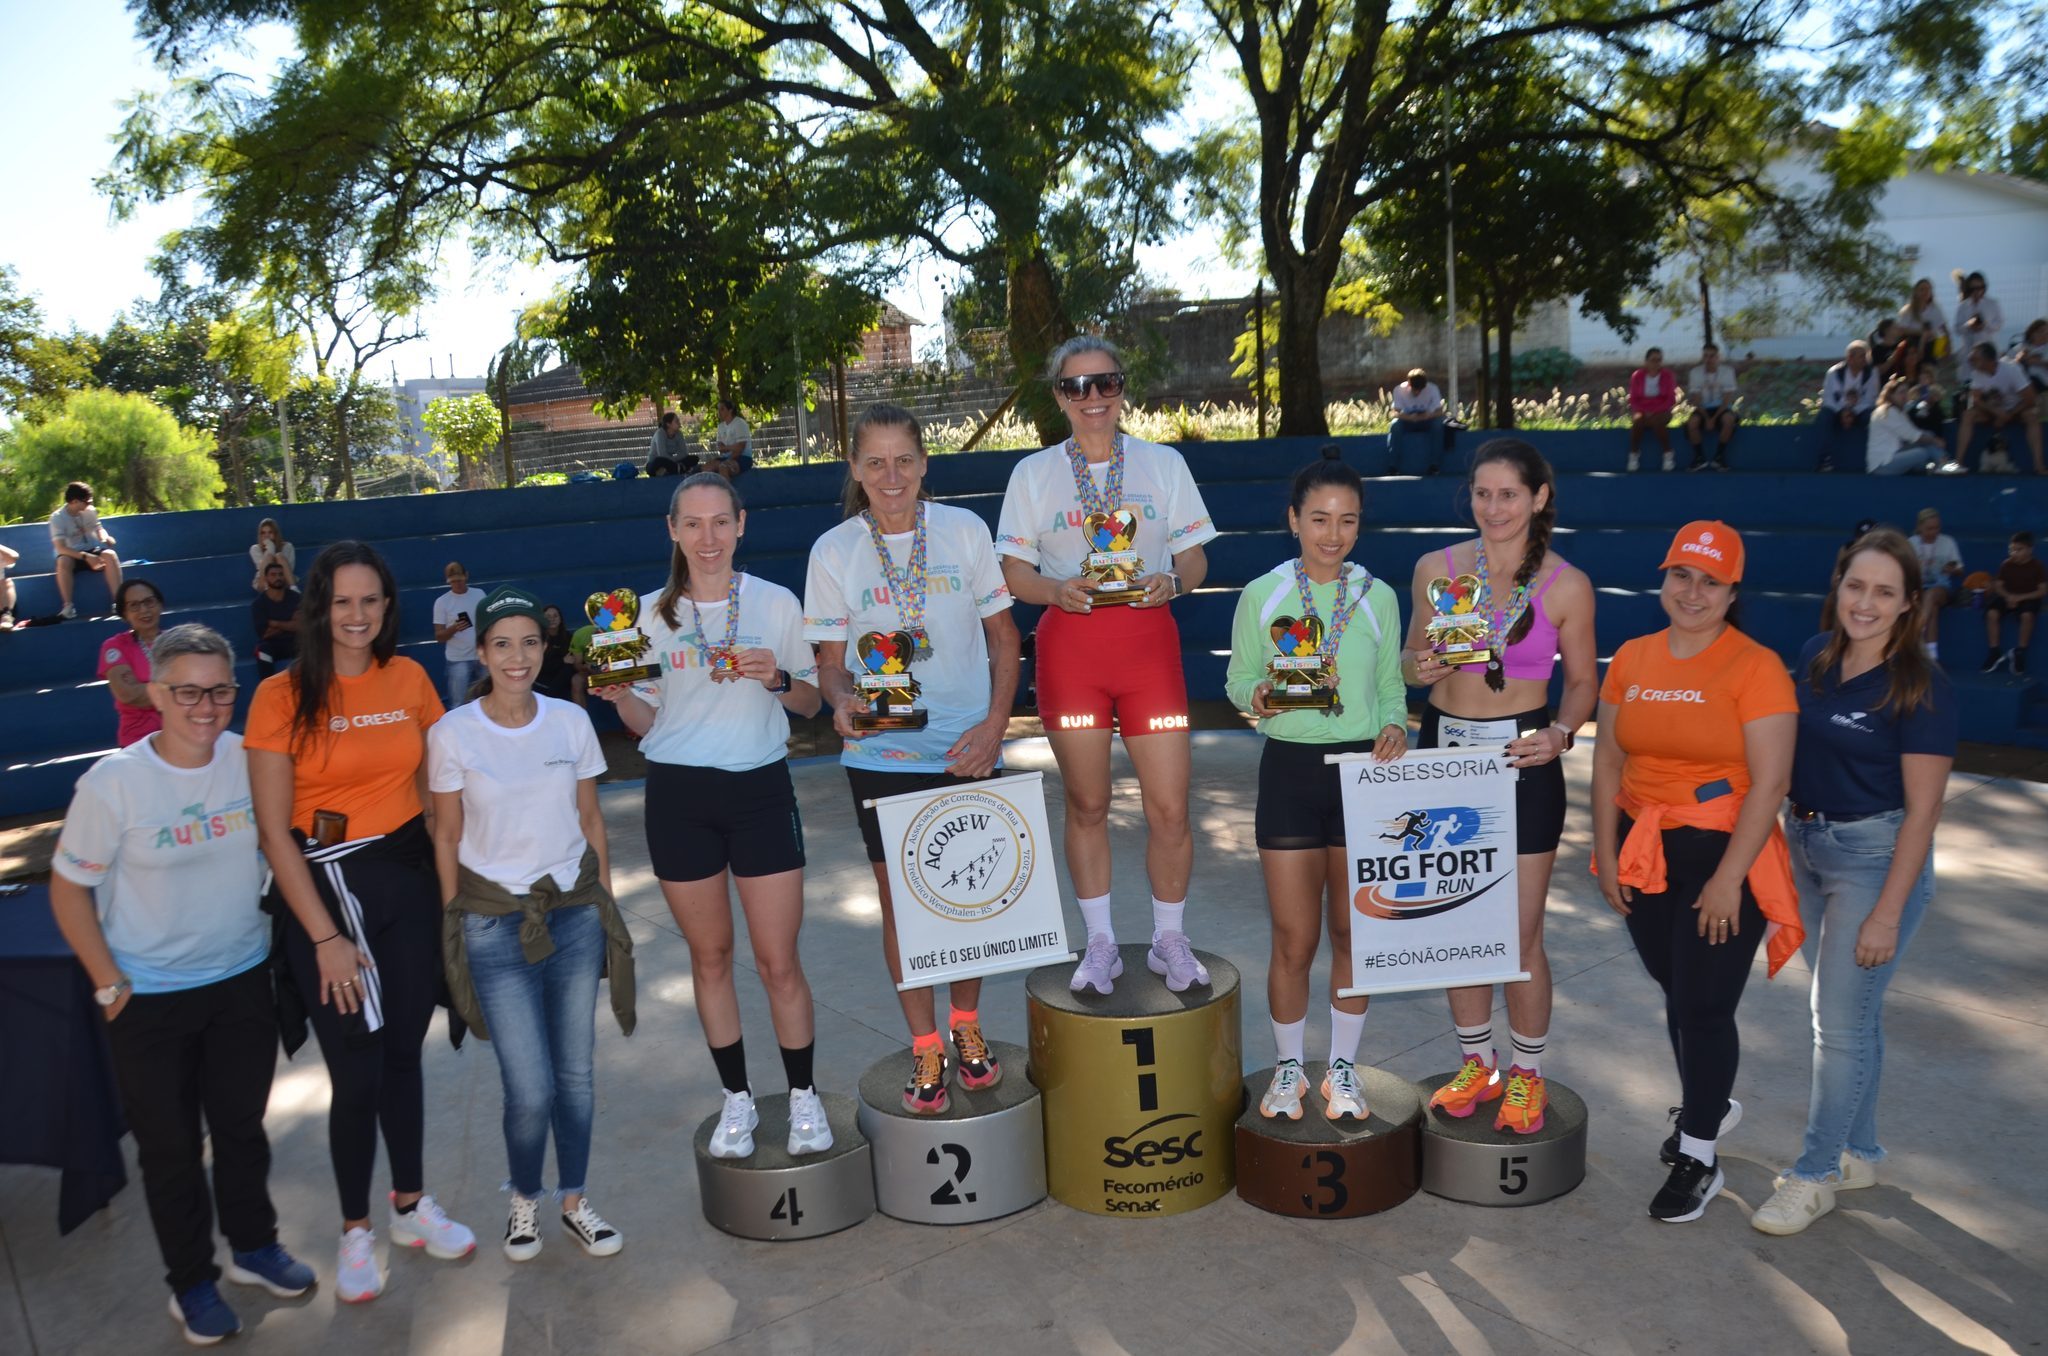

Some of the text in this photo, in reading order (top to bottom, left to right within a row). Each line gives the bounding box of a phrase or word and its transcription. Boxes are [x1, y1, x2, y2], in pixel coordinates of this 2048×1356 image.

[1053, 502, 1156, 533] Aumo
[1681, 543, 1723, 561] CRESOL
[861, 575, 961, 611] Aumo
[1641, 689, 1707, 703] CRESOL
[352, 709, 411, 728] CRESOL
[1060, 714, 1188, 730] RUN MORE
[1358, 758, 1499, 785] ASSESSORIA
[908, 793, 1019, 845] Associação de Corredores de Rua
[924, 813, 991, 870] ACORFW
[908, 862, 929, 899] Frederico
[1009, 849, 1031, 897] Desde 2024
[1357, 848, 1498, 884] BIG FORT
[1436, 877, 1475, 895] RUN
[909, 931, 1059, 971] VOCÊ É O SEU ÚNICO LIMITE!
[1365, 943, 1506, 969] #ÉSÓNÃOPARAR
[1121, 1026, 1158, 1112] 1
[926, 1143, 977, 1206] 2
[1103, 1172, 1204, 1194] Fecomércio
[1301, 1150, 1348, 1214] 3
[1498, 1156, 1529, 1195] 5
[770, 1187, 803, 1226] 4
[1105, 1198, 1161, 1212] Senac
